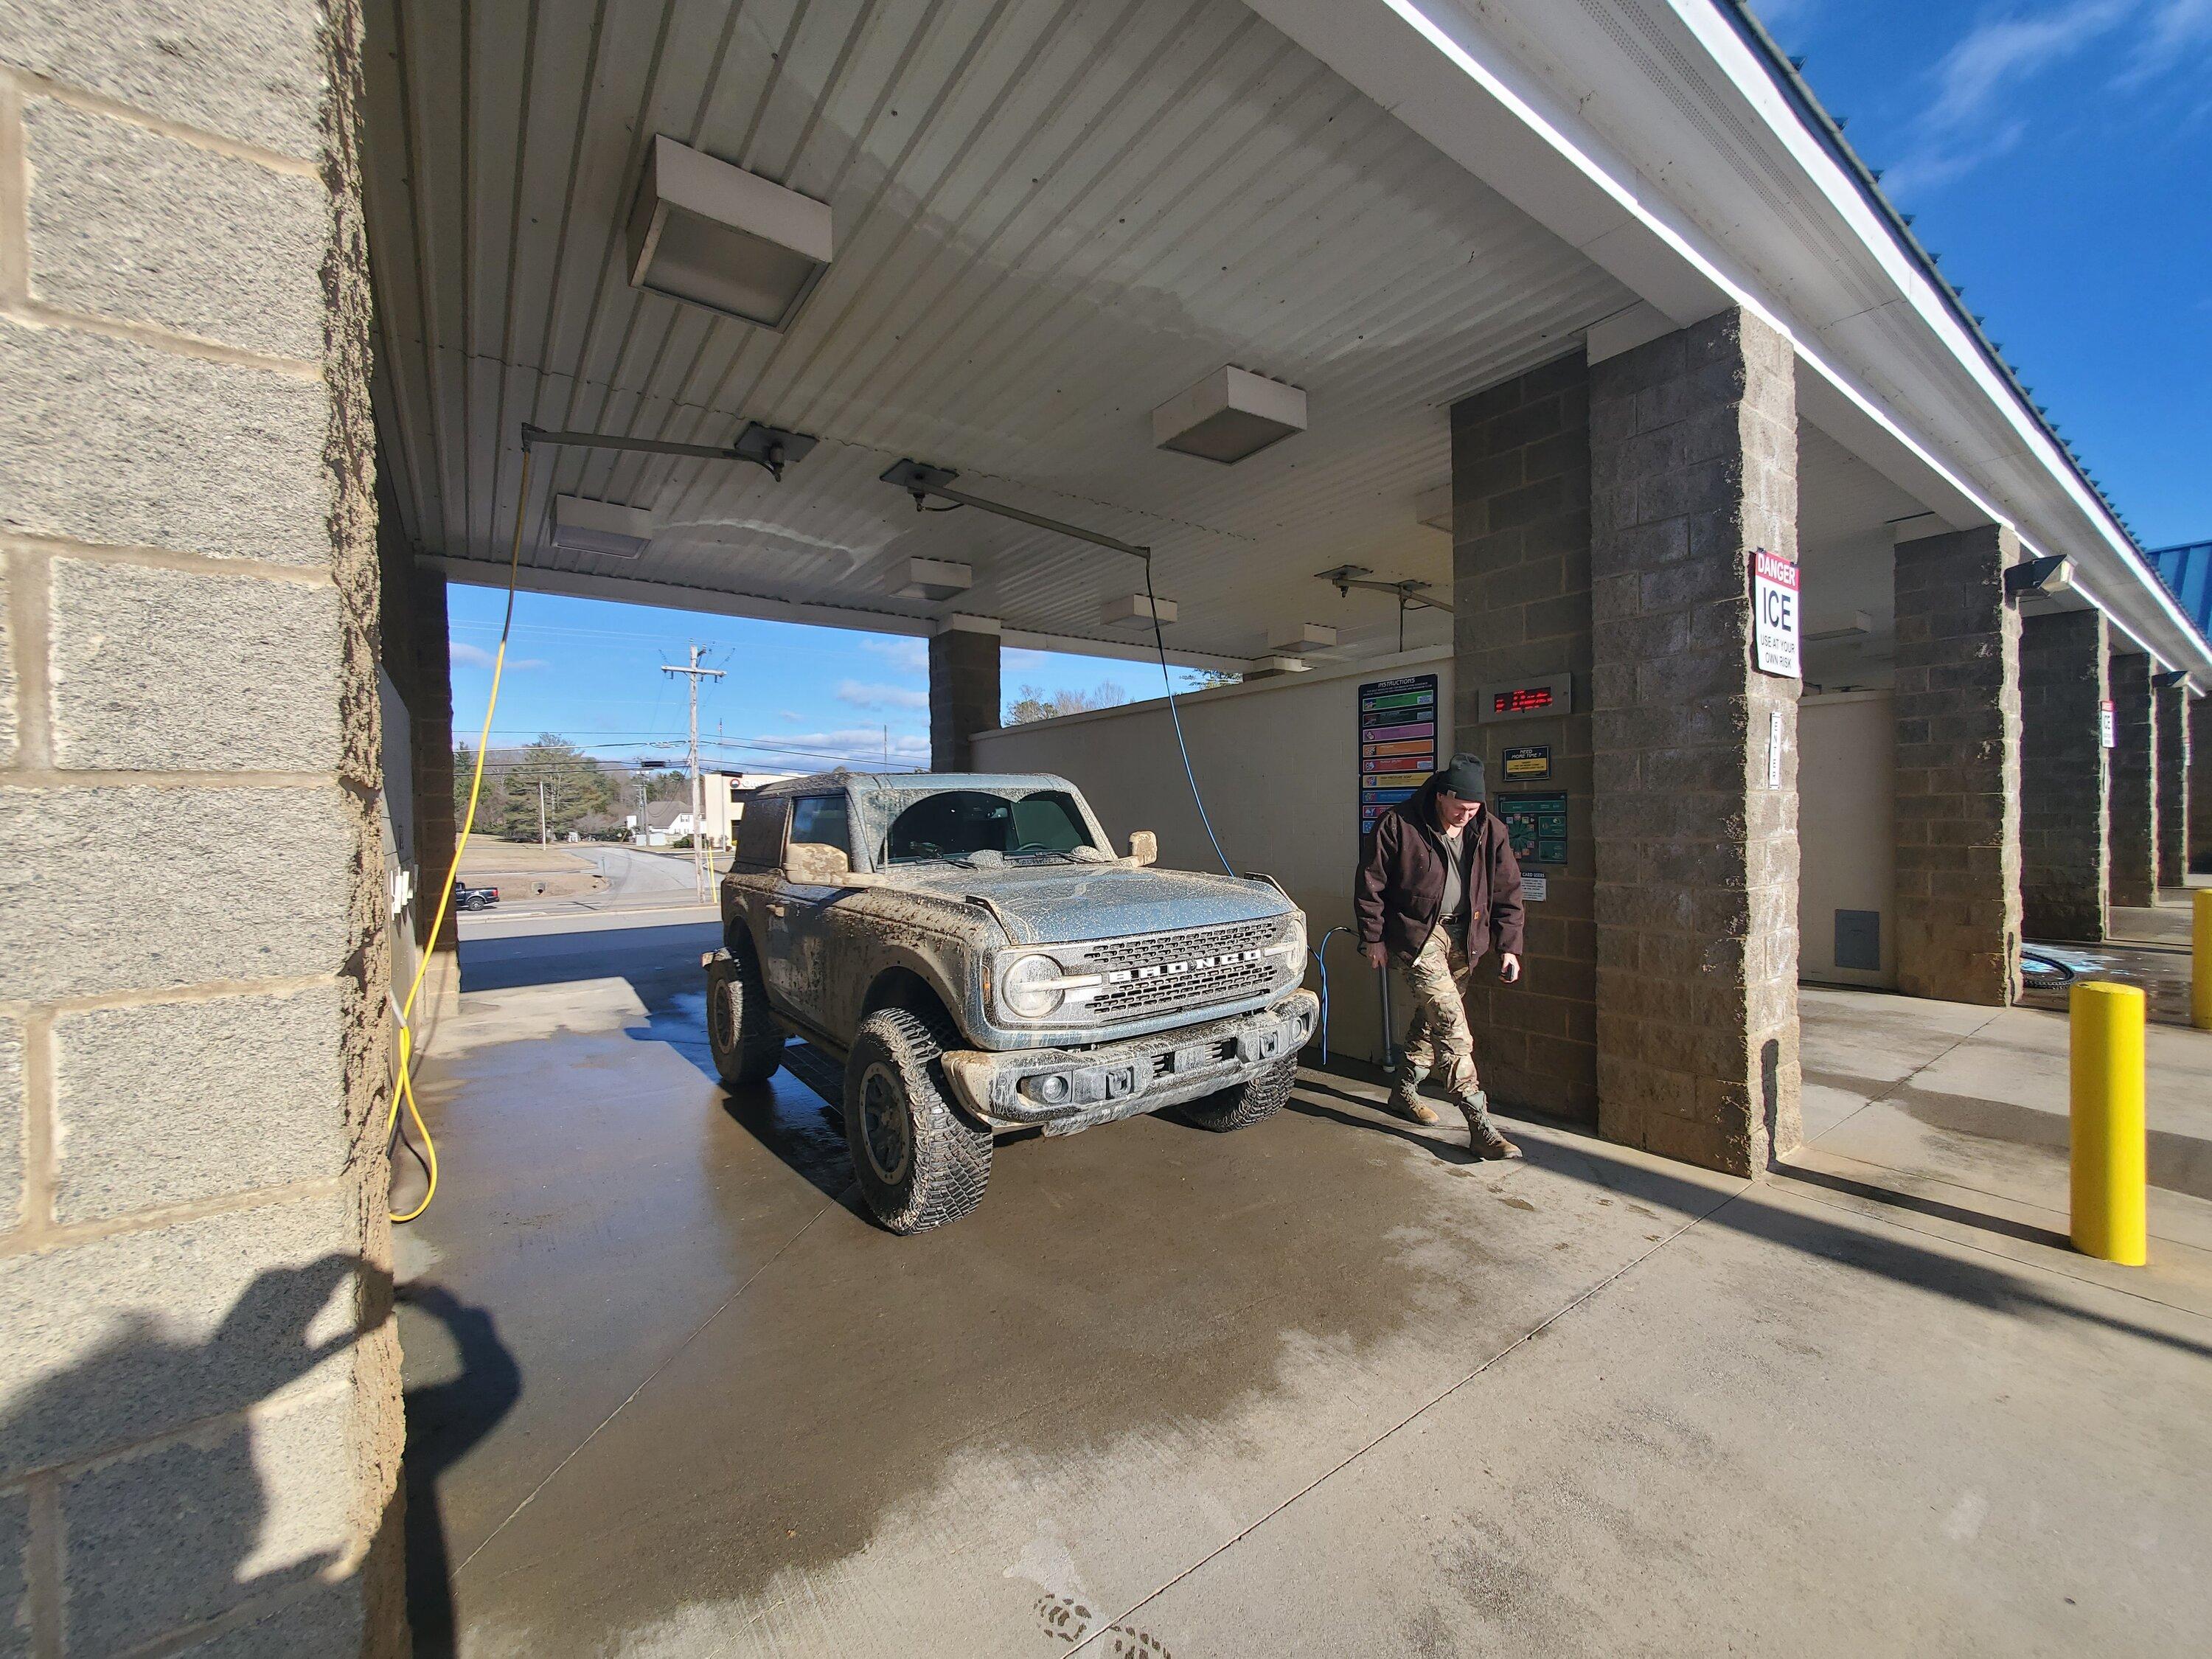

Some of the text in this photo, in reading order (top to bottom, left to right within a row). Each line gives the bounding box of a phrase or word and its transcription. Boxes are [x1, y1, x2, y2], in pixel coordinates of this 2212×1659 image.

[1758, 552, 1796, 587] DANGER
[1763, 587, 1791, 632] ICE
[1760, 633, 1795, 655] USE AT YOUR
[1765, 652, 1792, 669] OWN RISK
[1377, 677, 1416, 689] INSTRUCTIONS
[1108, 949, 1262, 984] BRONCO
